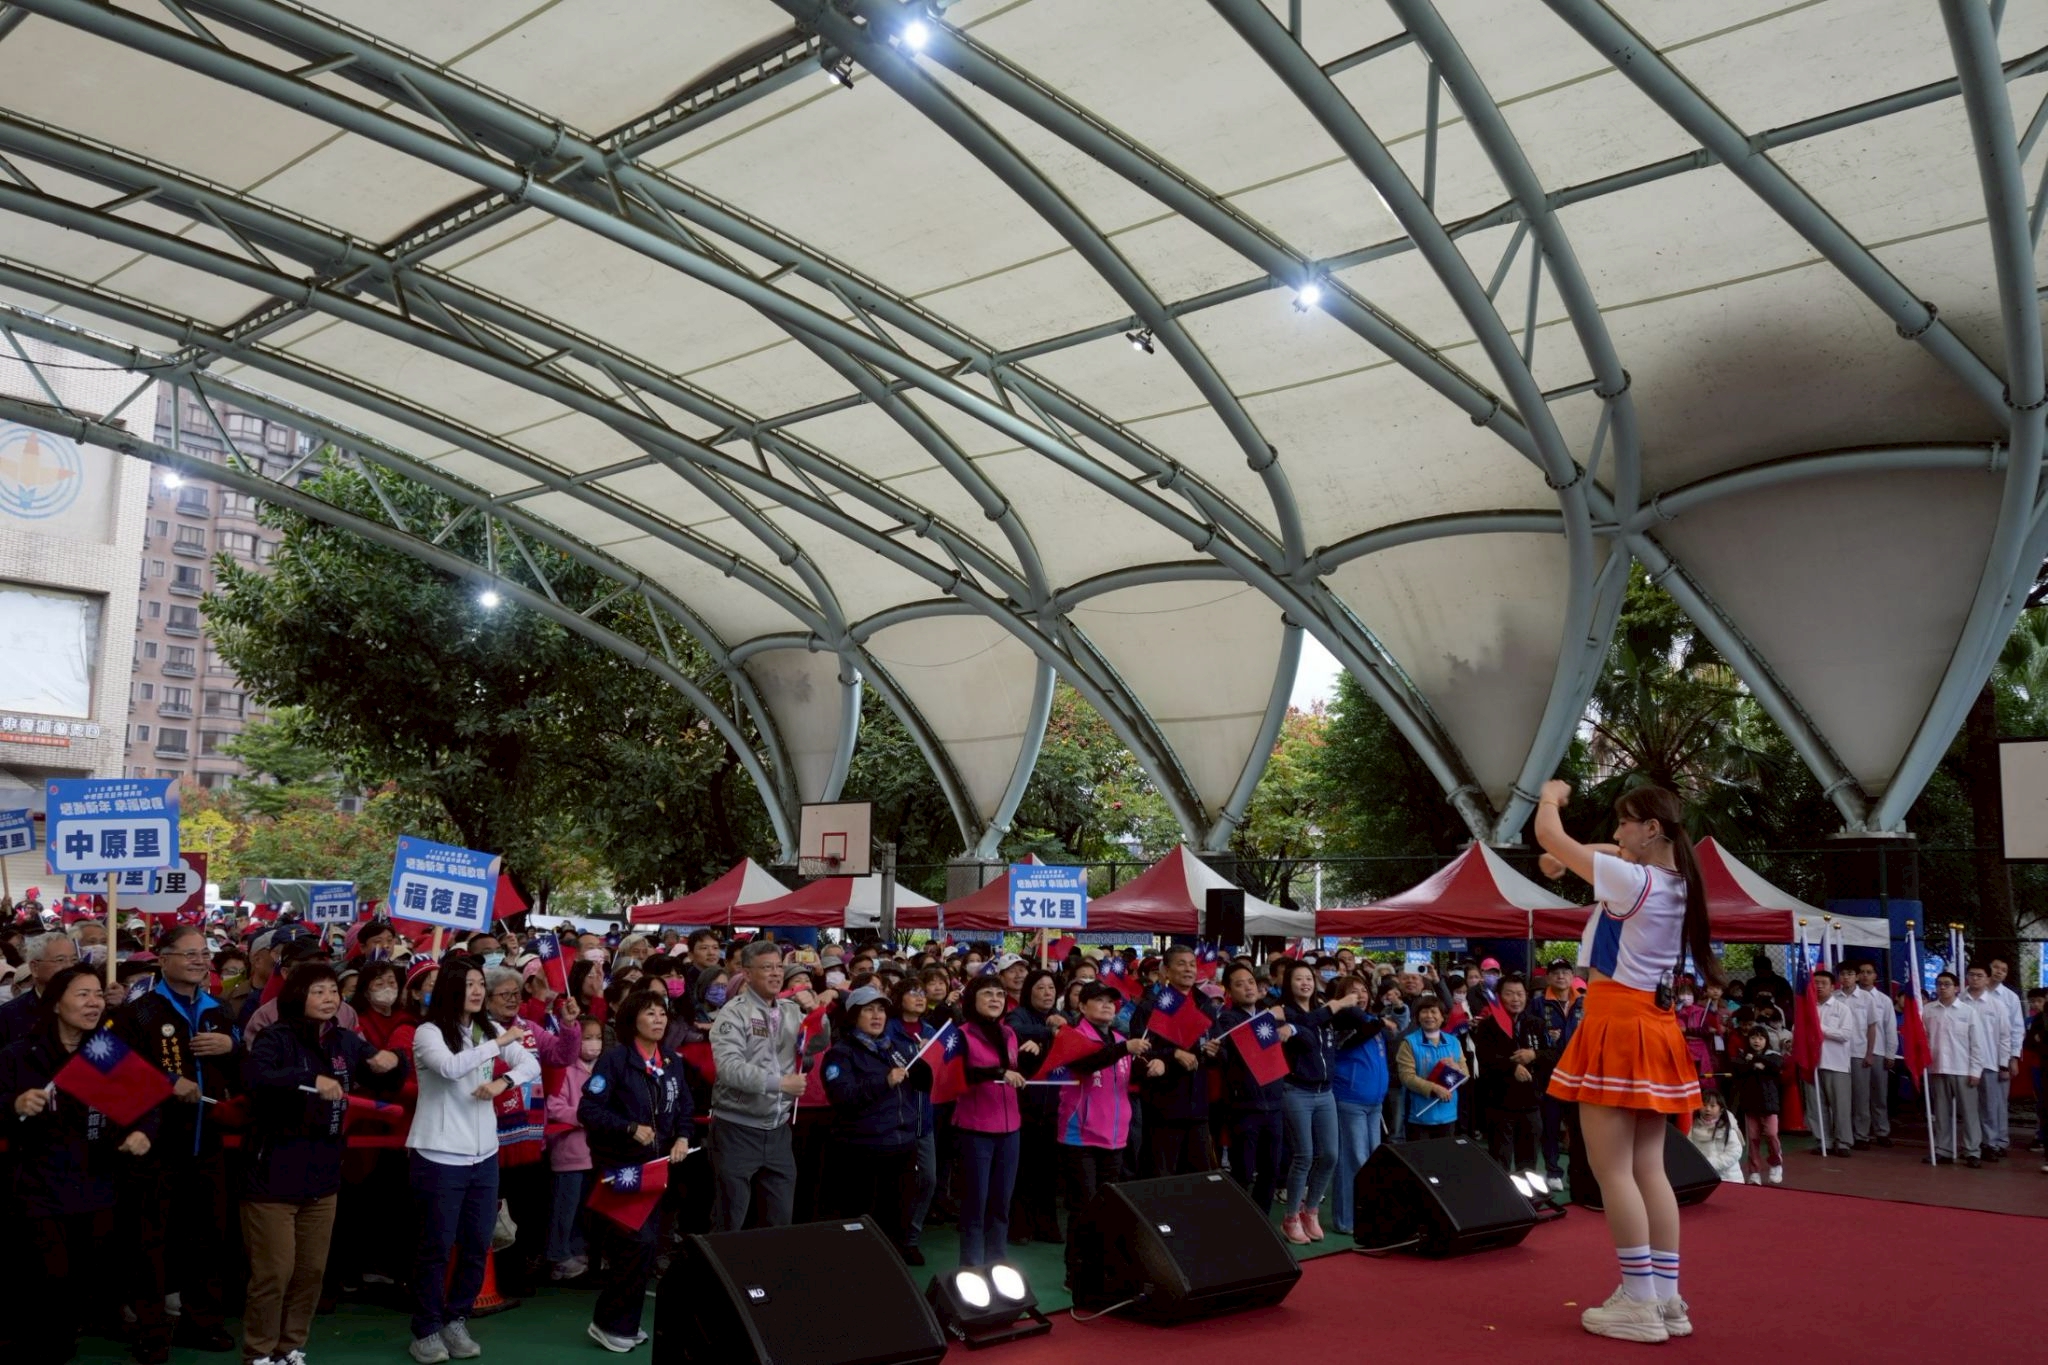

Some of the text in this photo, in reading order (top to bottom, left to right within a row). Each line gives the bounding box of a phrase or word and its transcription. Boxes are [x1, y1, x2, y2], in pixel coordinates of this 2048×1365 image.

[65, 828, 160, 860] 中原里
[316, 904, 350, 918] 和平里
[403, 881, 479, 920] 福德里
[1020, 897, 1076, 919] 文化里
